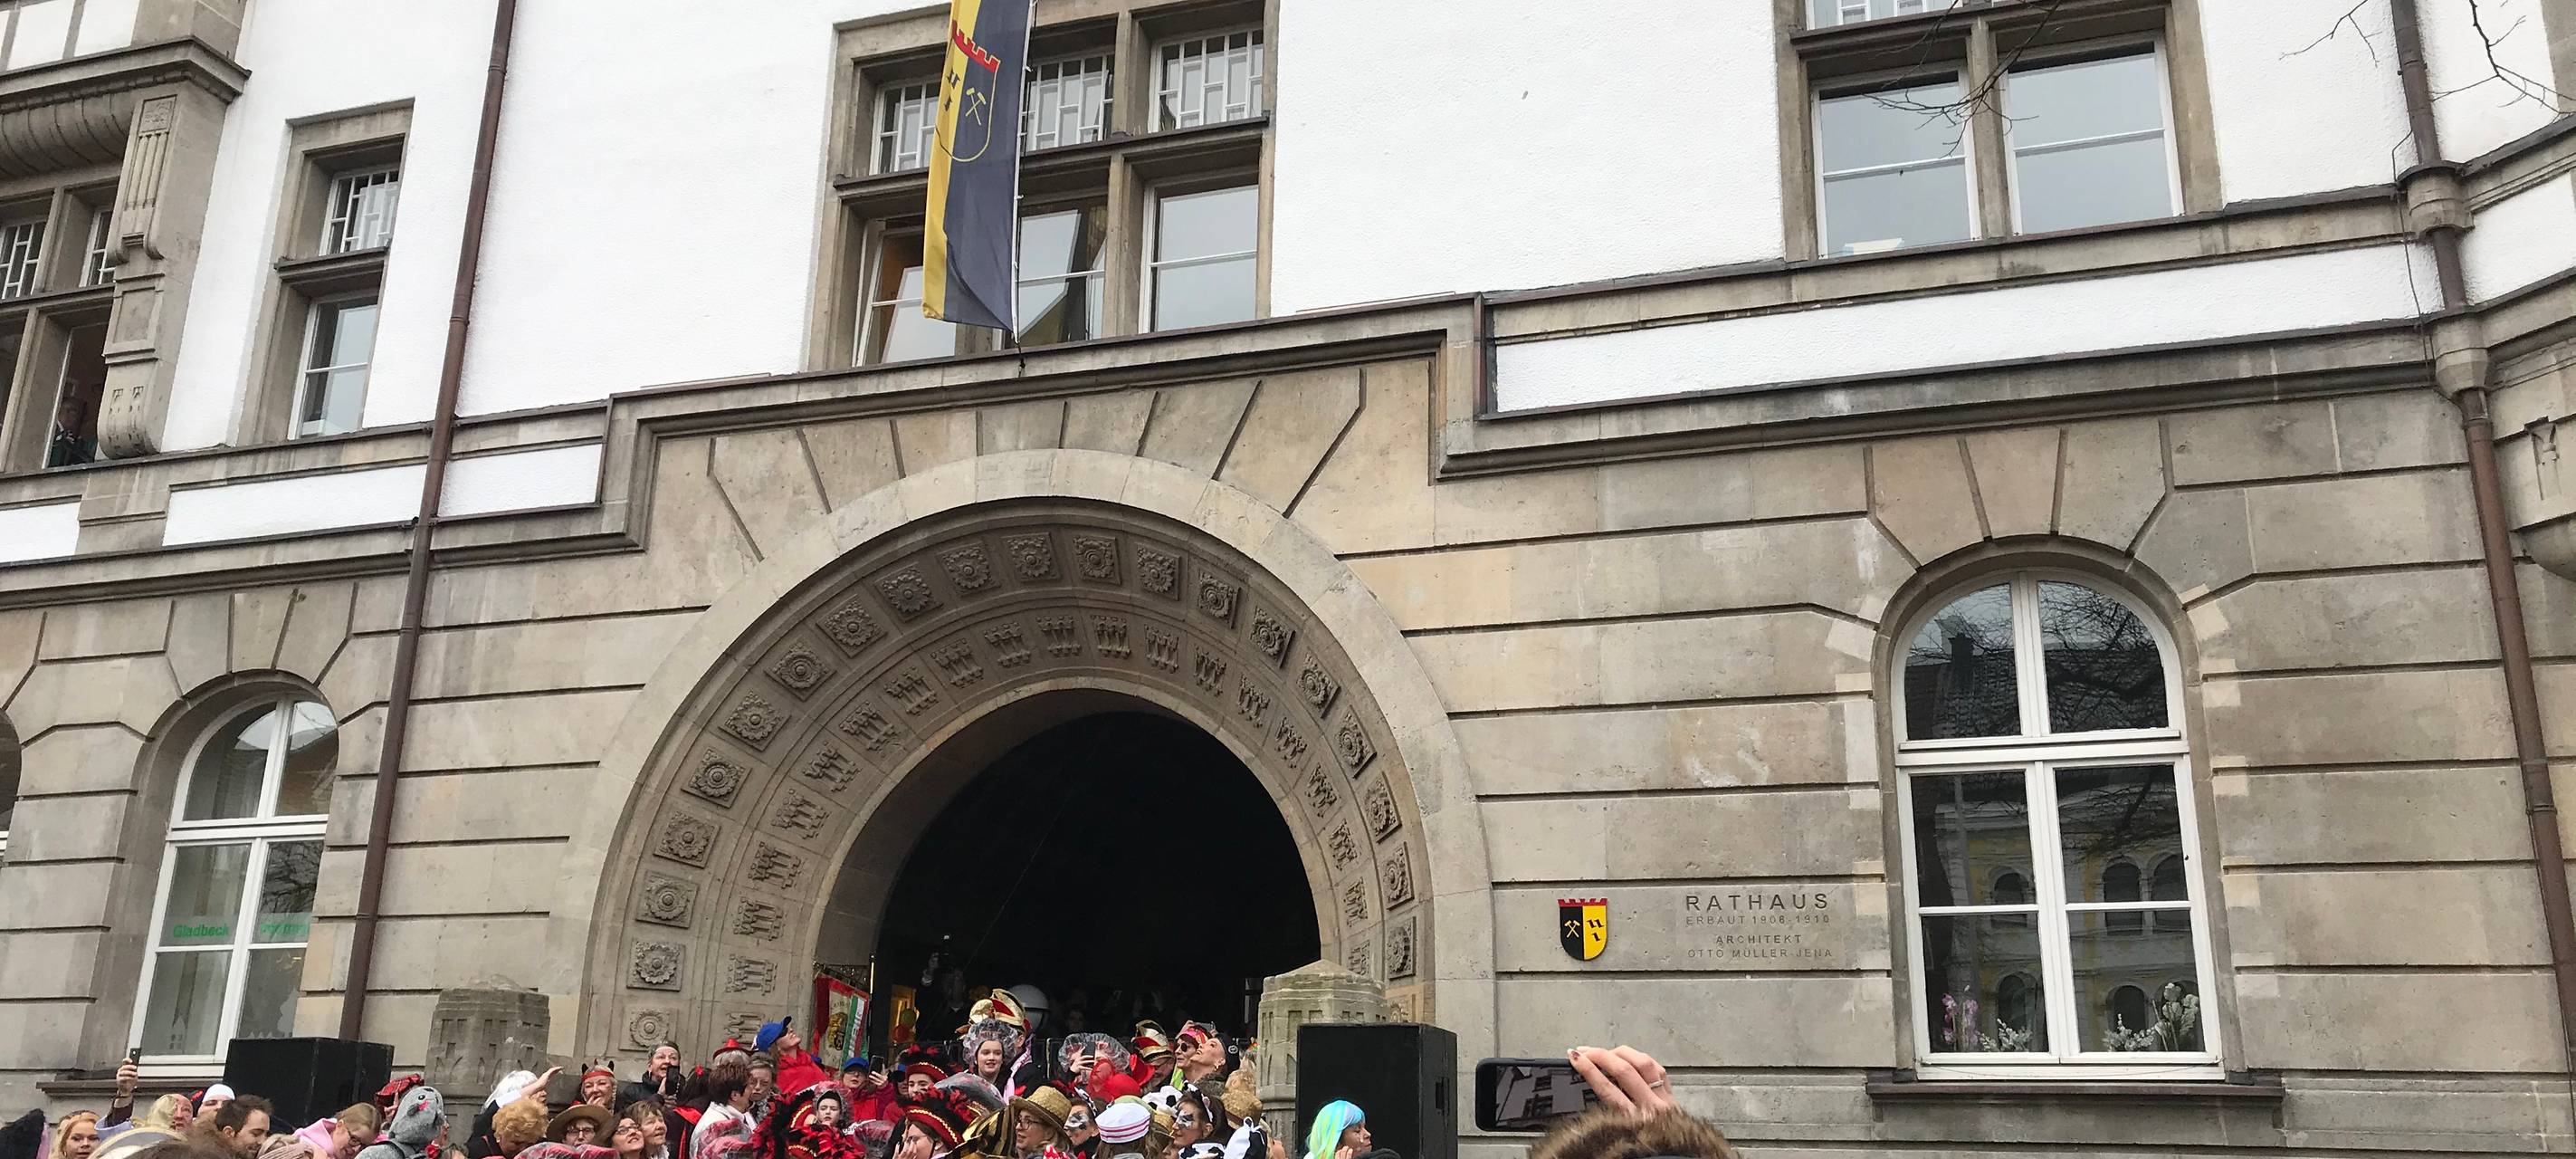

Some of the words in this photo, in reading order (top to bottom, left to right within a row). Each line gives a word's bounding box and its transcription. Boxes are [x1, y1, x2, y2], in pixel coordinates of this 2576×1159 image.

[1685, 894, 1828, 911] RATHAUS
[1685, 915, 1746, 925] ERBAUT
[1716, 934, 1802, 943] ARCHITEKT
[1687, 949, 1724, 958] OTTO
